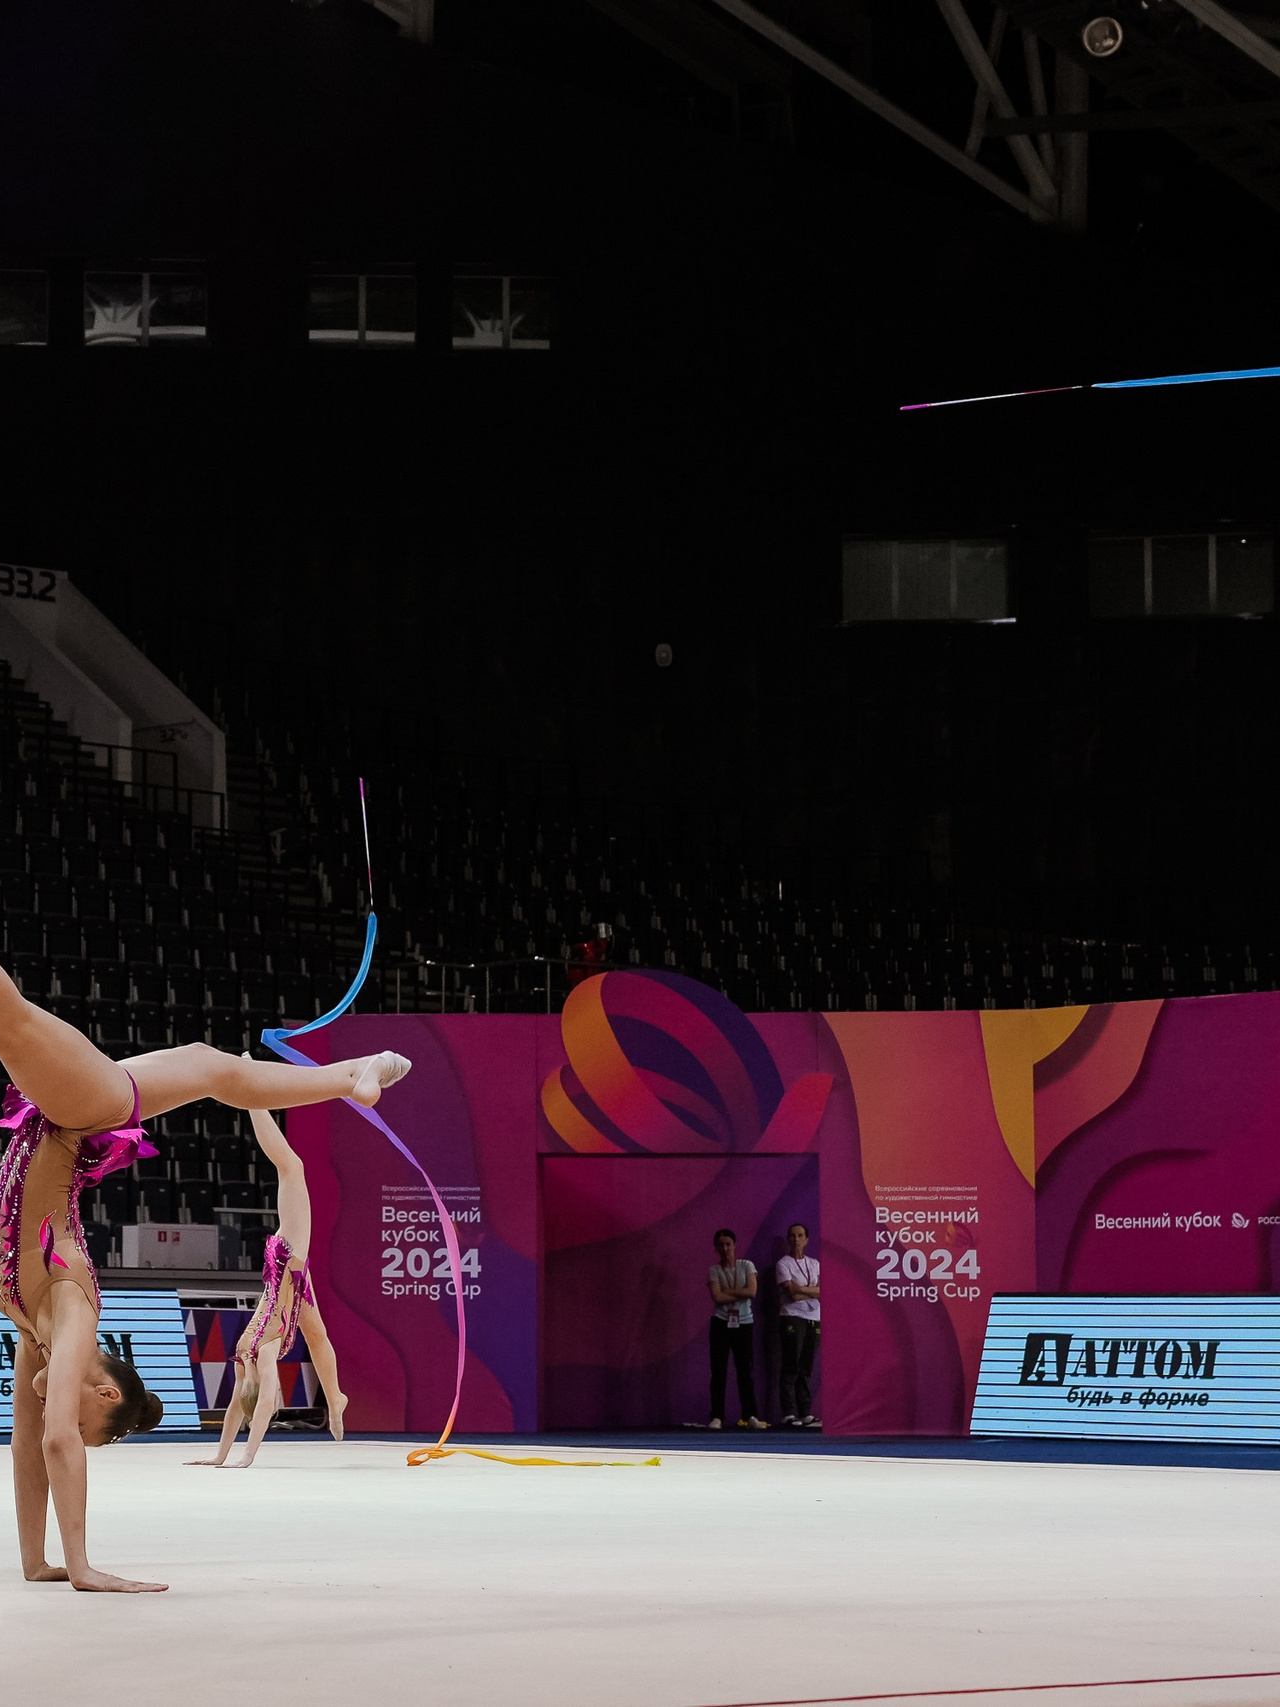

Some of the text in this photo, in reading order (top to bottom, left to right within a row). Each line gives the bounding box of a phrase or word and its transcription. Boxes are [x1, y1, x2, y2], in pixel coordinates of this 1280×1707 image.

[875, 1206, 979, 1224] Весенний
[1095, 1211, 1222, 1232] Весенний кубок
[381, 1225, 440, 1247] кубок
[875, 1226, 937, 1248] кубок
[381, 1247, 482, 1279] 2024
[876, 1248, 981, 1280] 2024
[381, 1280, 441, 1301] Spring
[877, 1282, 981, 1303] Spring Cup
[1066, 1386, 1210, 1410] будь в форме
